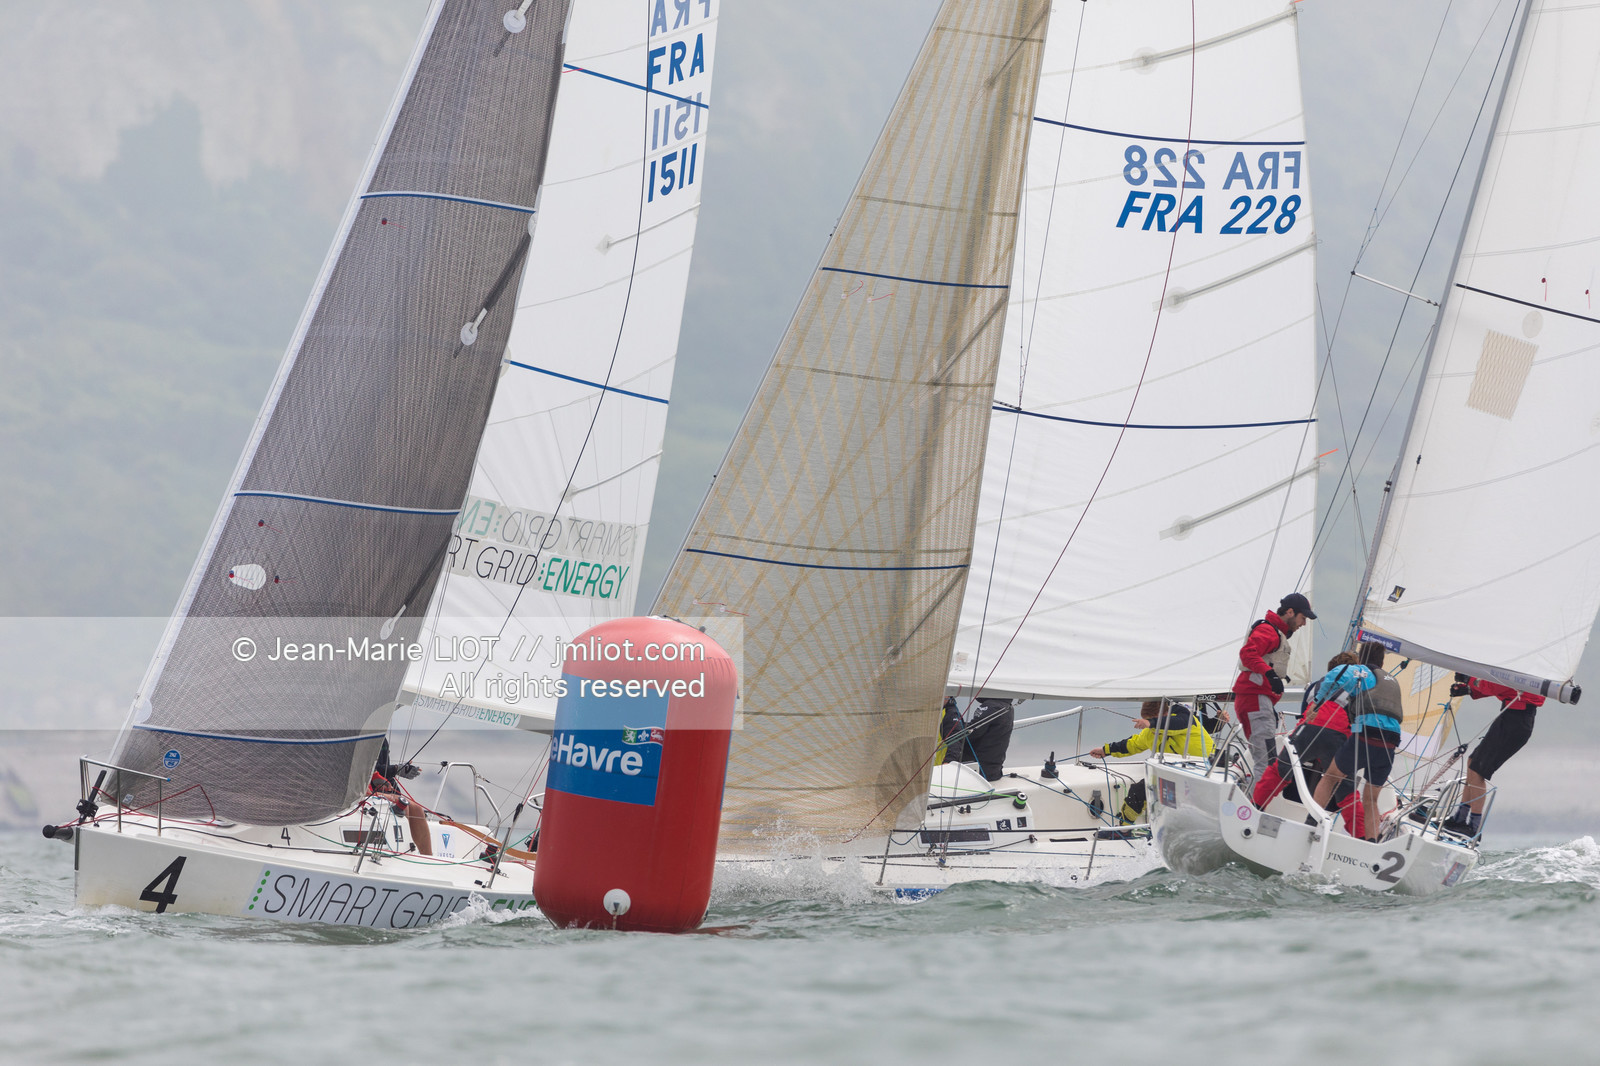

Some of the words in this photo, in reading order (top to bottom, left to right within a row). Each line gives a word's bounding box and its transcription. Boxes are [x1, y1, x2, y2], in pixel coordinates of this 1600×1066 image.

[649, 33, 704, 92] FRA
[648, 143, 697, 203] 1511
[1116, 190, 1203, 233] FRA
[1219, 194, 1301, 234] 228
[281, 827, 291, 846] 4
[139, 855, 187, 914] 4
[1376, 851, 1406, 883] 2
